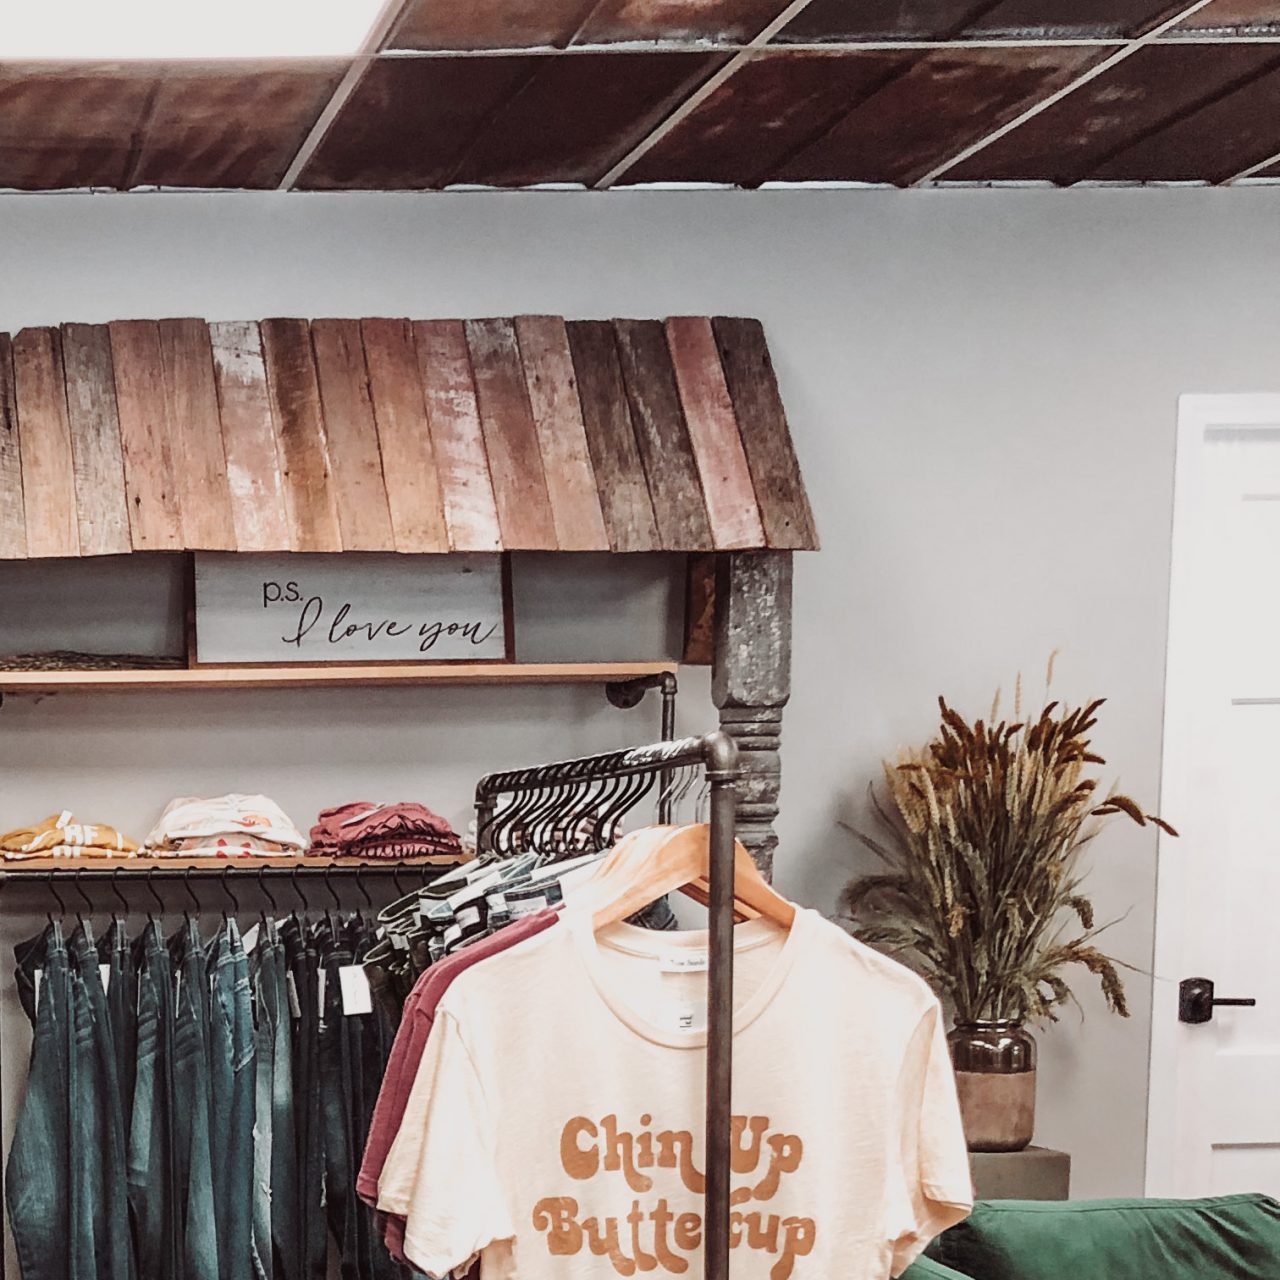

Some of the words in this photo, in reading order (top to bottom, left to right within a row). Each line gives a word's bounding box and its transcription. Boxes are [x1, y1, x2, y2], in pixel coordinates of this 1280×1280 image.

[328, 603, 412, 644] love
[418, 621, 498, 652] you
[560, 1114, 706, 1194] Chin
[730, 1115, 803, 1200] Up
